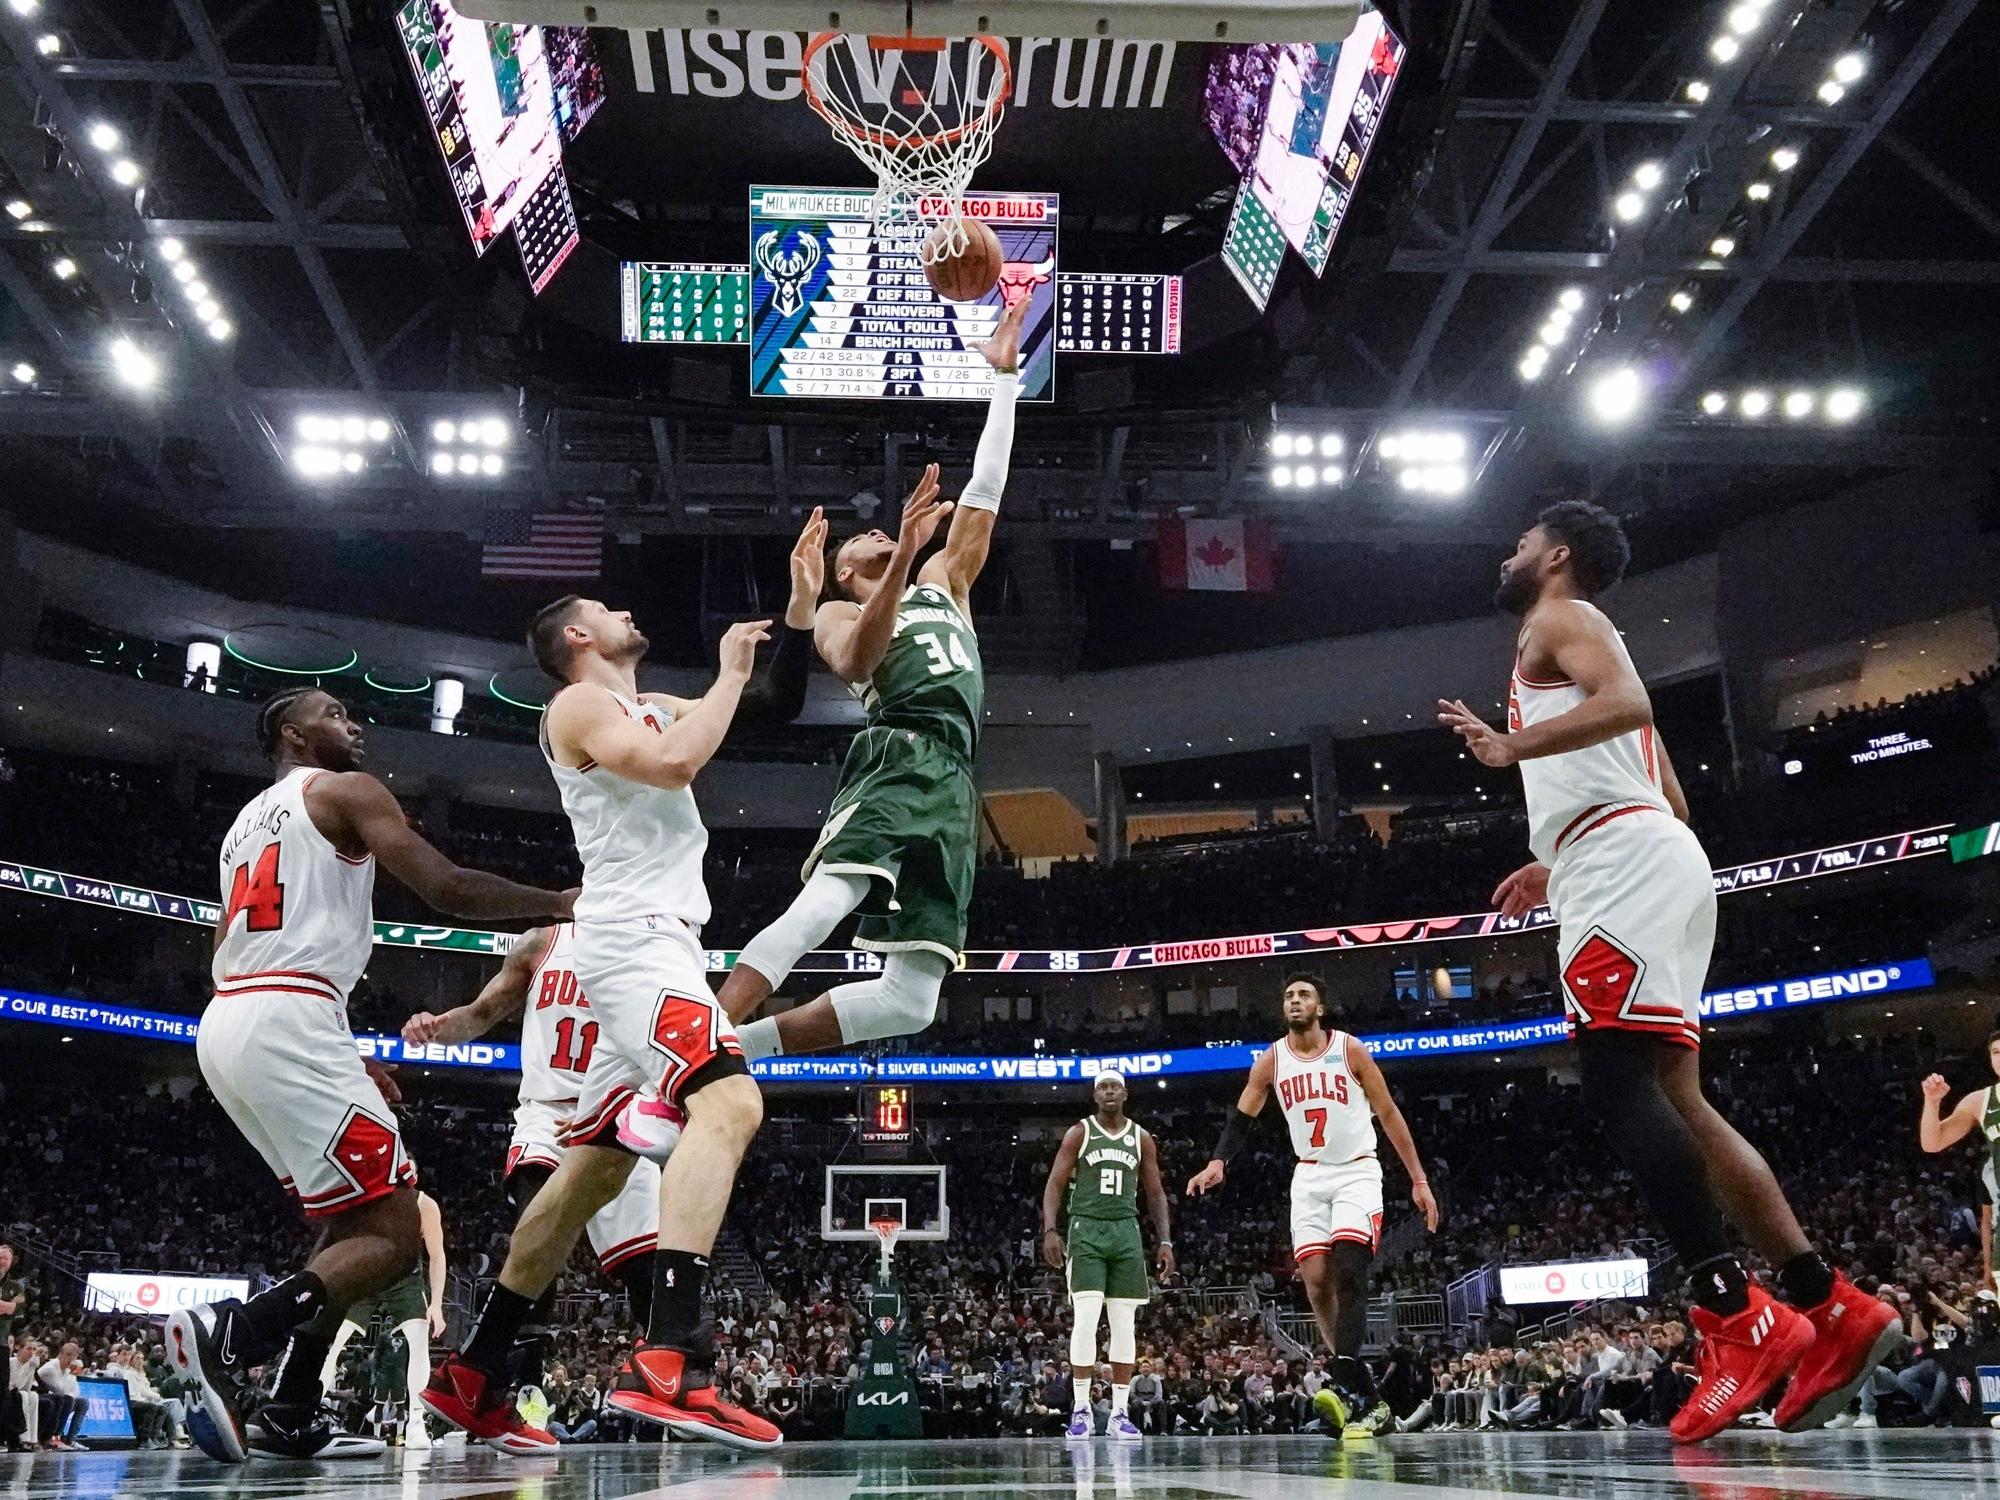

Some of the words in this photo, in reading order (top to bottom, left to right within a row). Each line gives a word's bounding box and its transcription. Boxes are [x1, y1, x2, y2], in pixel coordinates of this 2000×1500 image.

[766, 196, 840, 212] MILWAUKEE
[997, 202, 1044, 218] BULLS
[844, 226, 856, 234] 10
[847, 258, 853, 266] 3
[673, 275, 681, 284] 4
[696, 275, 700, 285] 1
[716, 276, 720, 286] 1
[736, 276, 741, 286] 1
[847, 273, 853, 281] 4
[877, 273, 903, 284] OFF
[653, 288, 660, 298] 7
[673, 289, 681, 298] 4
[694, 289, 702, 299] 2
[716, 290, 720, 299] 1
[736, 290, 741, 300] 1
[844, 289, 856, 297] 22
[877, 289, 903, 300] DEF
[905, 290, 932, 300] REB
[1063, 284, 1072, 294] 0
[1082, 285, 1093, 295] 11
[1104, 285, 1112, 295] 2
[1125, 286, 1130, 296] 1
[1143, 286, 1152, 296] 0
[1064, 298, 1072, 308] 7
[1083, 299, 1092, 308] 3
[1103, 299, 1112, 309] 3
[1123, 300, 1131, 310] 2
[1143, 300, 1151, 310] 0
[1169, 280, 1179, 320] CHICAGO
[651, 302, 663, 312] 21
[864, 304, 944, 317] TURNOVERS
[972, 307, 978, 316] 9
[696, 317, 701, 327] 1
[1083, 312, 1091, 322] 2
[1103, 313, 1111, 323] 7
[1124, 314, 1129, 323] 1
[1144, 314, 1150, 323] 1
[860, 321, 902, 332] TOTAL
[904, 322, 947, 333] FOULS
[972, 324, 978, 332] 8
[1062, 326, 1072, 335] 11
[1082, 326, 1091, 336] 2
[1104, 327, 1109, 336] 1
[1122, 327, 1131, 337] 3
[1142, 327, 1150, 337] 2
[716, 332, 721, 341] 1
[737, 332, 742, 342] 1
[856, 336, 900, 348] BENCH
[903, 338, 952, 349] POINTS
[1168, 322, 1177, 350] BULLS
[1058, 339, 1074, 349] 44
[1080, 340, 1093, 349] 10
[1102, 340, 1110, 350] 0
[1122, 341, 1130, 350] 0
[1143, 341, 1148, 351] 1
[793, 352, 806, 360] 22
[819, 352, 833, 360] 42
[895, 353, 912, 364] FG
[821, 368, 832, 376] 13
[890, 369, 916, 380] 3PT
[895, 384, 912, 395] FT
[913, 632, 974, 675] 34
[1851, 751, 1878, 764] TWO
[222, 804, 290, 866] WILLIAMS
[1742, 868, 1772, 883] FLS
[1793, 862, 1800, 873] 1
[1821, 851, 1856, 868] TOL
[33, 874, 55, 889] FT
[120, 892, 150, 908] FLS
[170, 903, 178, 913] 2
[1154, 941, 1221, 964] CHICAGO
[1226, 937, 1273, 957] BULLS
[1050, 953, 1080, 970] 35
[12, 999, 46, 1016] OUR
[100, 1012, 151, 1030] THAT'S
[154, 1020, 183, 1034] THE
[1384, 1038, 1414, 1052] OUT
[1418, 1037, 1449, 1049] OUR
[1496, 1026, 1542, 1043] THAT'S
[1543, 1022, 1569, 1036] THE
[550, 1016, 599, 1073] 11
[812, 1064, 857, 1074] THAT'S
[888, 1064, 926, 1074] SILVER
[992, 1060, 1075, 1077] WEST
[880, 1089, 906, 1104] 1:51
[1280, 1072, 1348, 1111] BULLS
[880, 1104, 901, 1130] 10
[1304, 1108, 1327, 1147] 7
[1100, 1168, 1123, 1196] 21
[1582, 1270, 1637, 1289] CLUB
